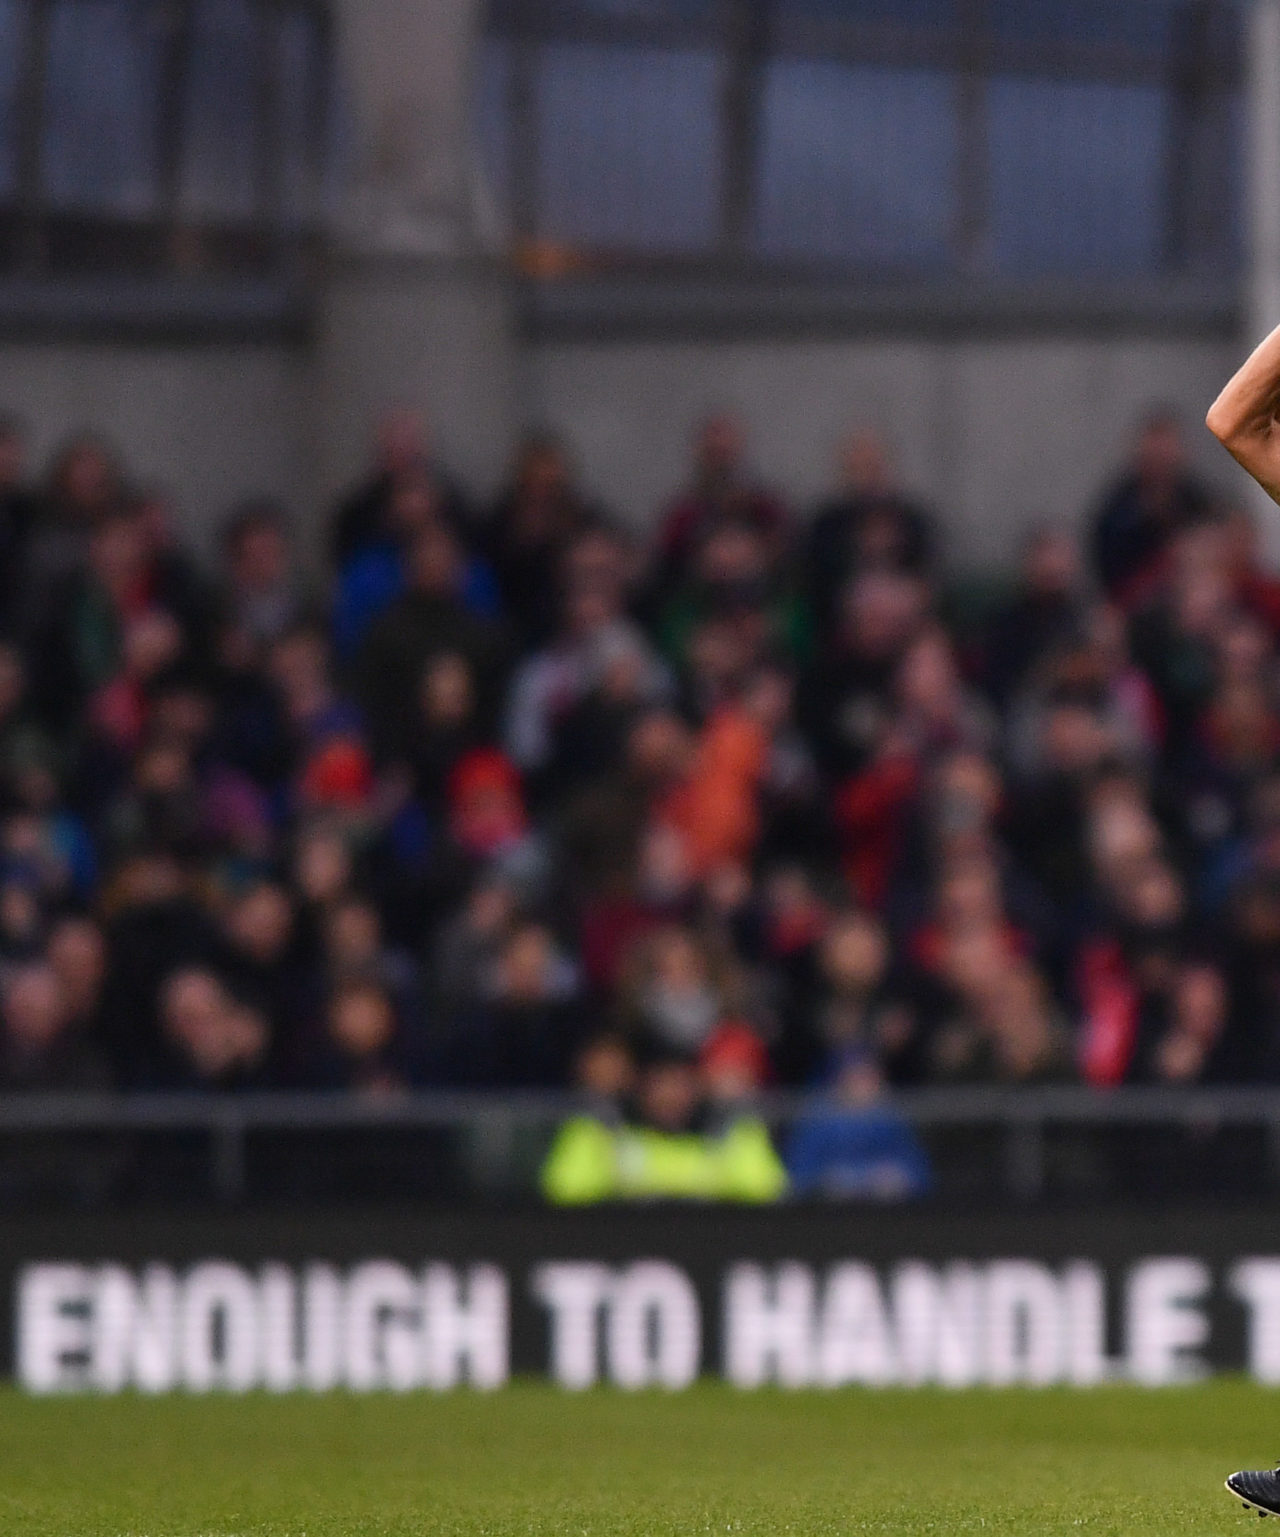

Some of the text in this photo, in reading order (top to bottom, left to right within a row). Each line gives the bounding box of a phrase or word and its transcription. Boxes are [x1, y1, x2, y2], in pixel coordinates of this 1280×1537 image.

[16, 1260, 509, 1393] ENOUGH
[536, 1260, 702, 1390] TO
[722, 1258, 1208, 1388] HANDLE
